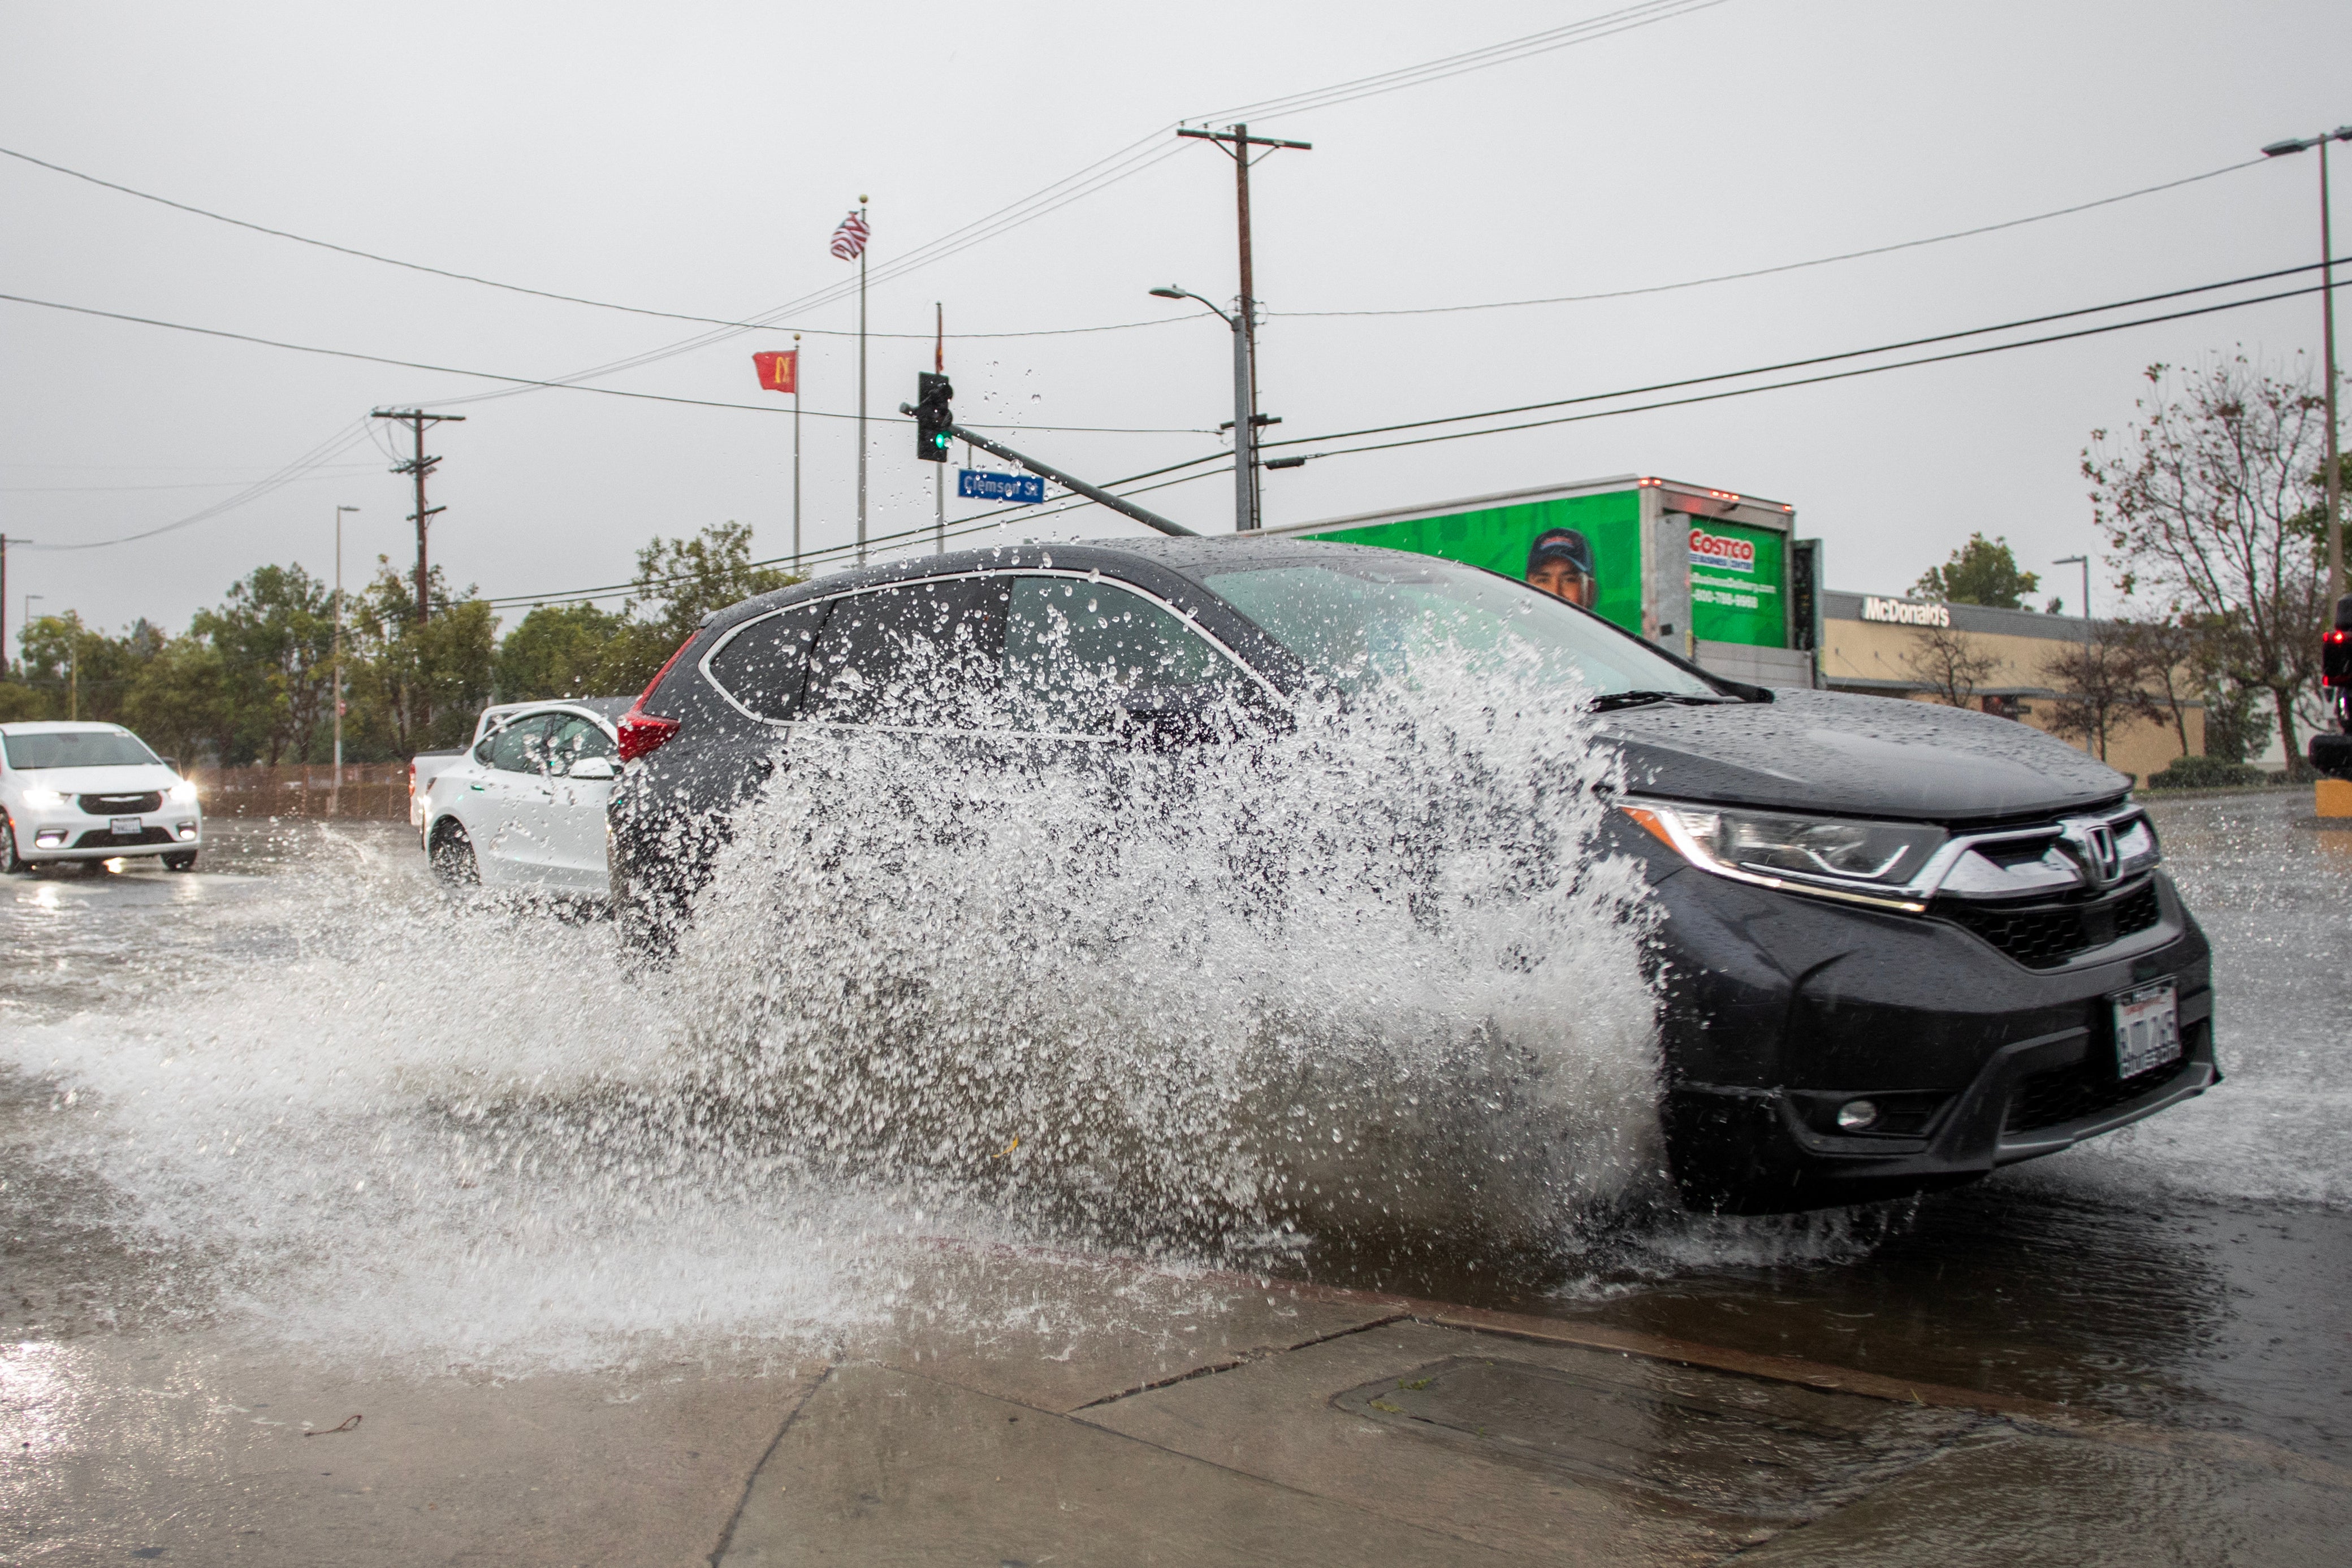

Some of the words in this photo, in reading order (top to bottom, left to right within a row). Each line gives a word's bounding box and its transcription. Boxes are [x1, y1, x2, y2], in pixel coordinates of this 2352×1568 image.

[963, 475, 1020, 495] Clemson
[1024, 481, 1039, 496] St
[1688, 529, 1753, 560] COSTCO
[1865, 596, 1950, 628] McDonald's
